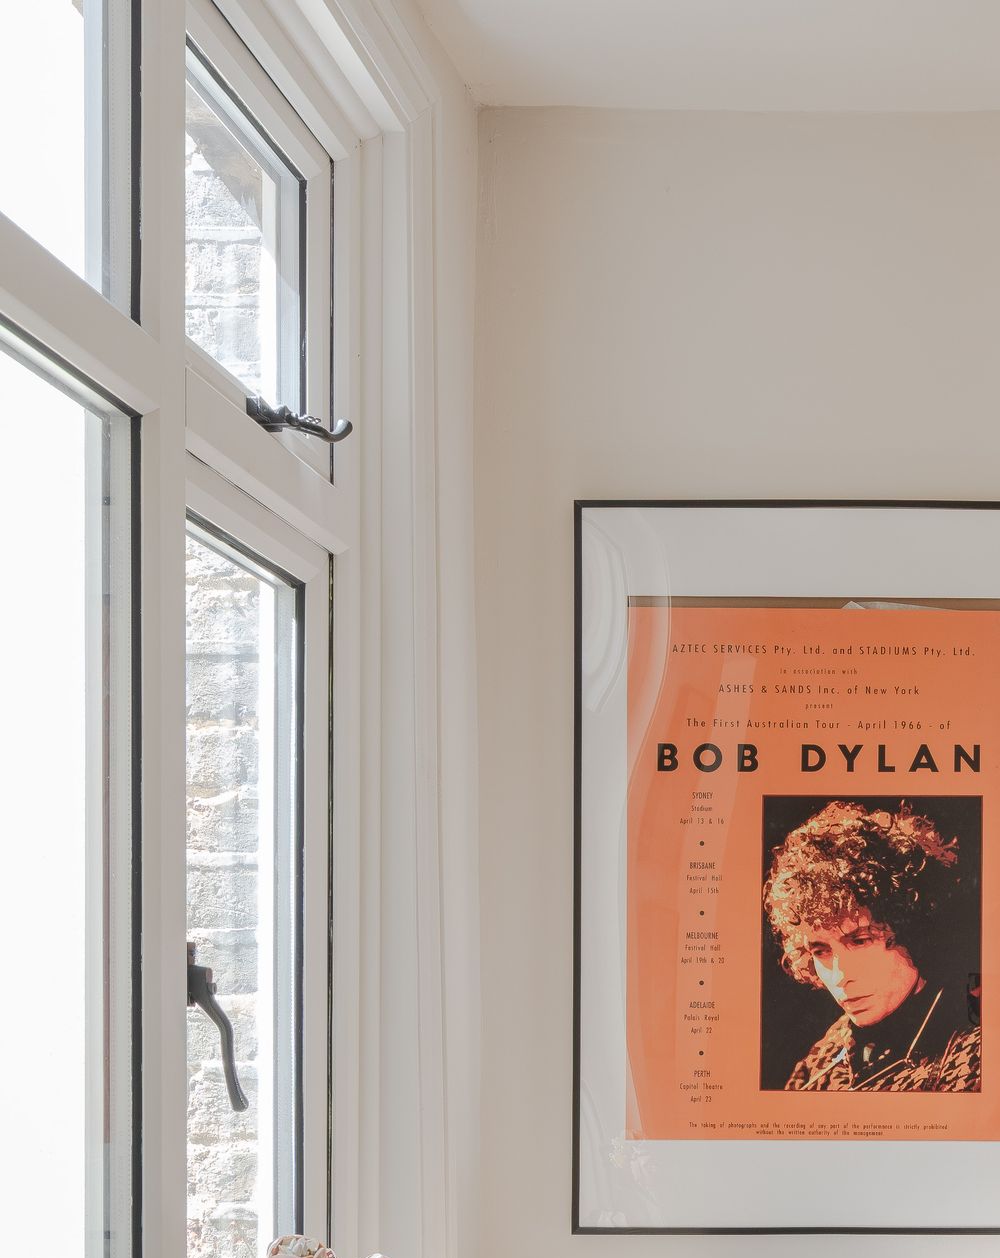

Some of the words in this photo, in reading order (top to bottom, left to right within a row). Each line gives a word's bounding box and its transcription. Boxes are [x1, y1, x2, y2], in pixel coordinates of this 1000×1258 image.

[671, 643, 707, 654] AZTEC
[712, 643, 767, 655] SERVICES
[774, 644, 796, 656] Pty.
[803, 644, 825, 657] Ltd.
[832, 645, 853, 655] and
[859, 645, 917, 656] STADIUMS
[923, 646, 946, 658] Pty.
[953, 646, 975, 657] Ltd.
[718, 683, 754, 694] ASHES
[760, 685, 768, 694] &
[774, 684, 812, 694] SANDS
[818, 684, 840, 695] Inc.
[846, 684, 859, 695] of
[865, 685, 888, 695] New
[893, 685, 920, 696] York
[686, 717, 706, 728] The
[713, 718, 740, 728] First
[746, 719, 809, 729] Australian
[815, 719, 840, 729] Tour
[857, 719, 886, 732] April
[893, 720, 922, 730] 1966
[939, 720, 951, 730] of
[657, 743, 758, 772] BOB
[801, 744, 980, 772] DYLAN
[692, 791, 714, 800] SYDNEY
[679, 817, 693, 825] April
[697, 817, 705, 825] 13
[717, 817, 725, 825] 16
[689, 861, 716, 870] BRISBANE
[686, 932, 719, 940] MELBOURNE
[689, 1001, 716, 1009] ADELAIDE
[704, 1014, 720, 1022] Royal
[690, 1027, 702, 1035] April
[693, 1070, 711, 1078] PERTH
[679, 1083, 699, 1091] Capitol
